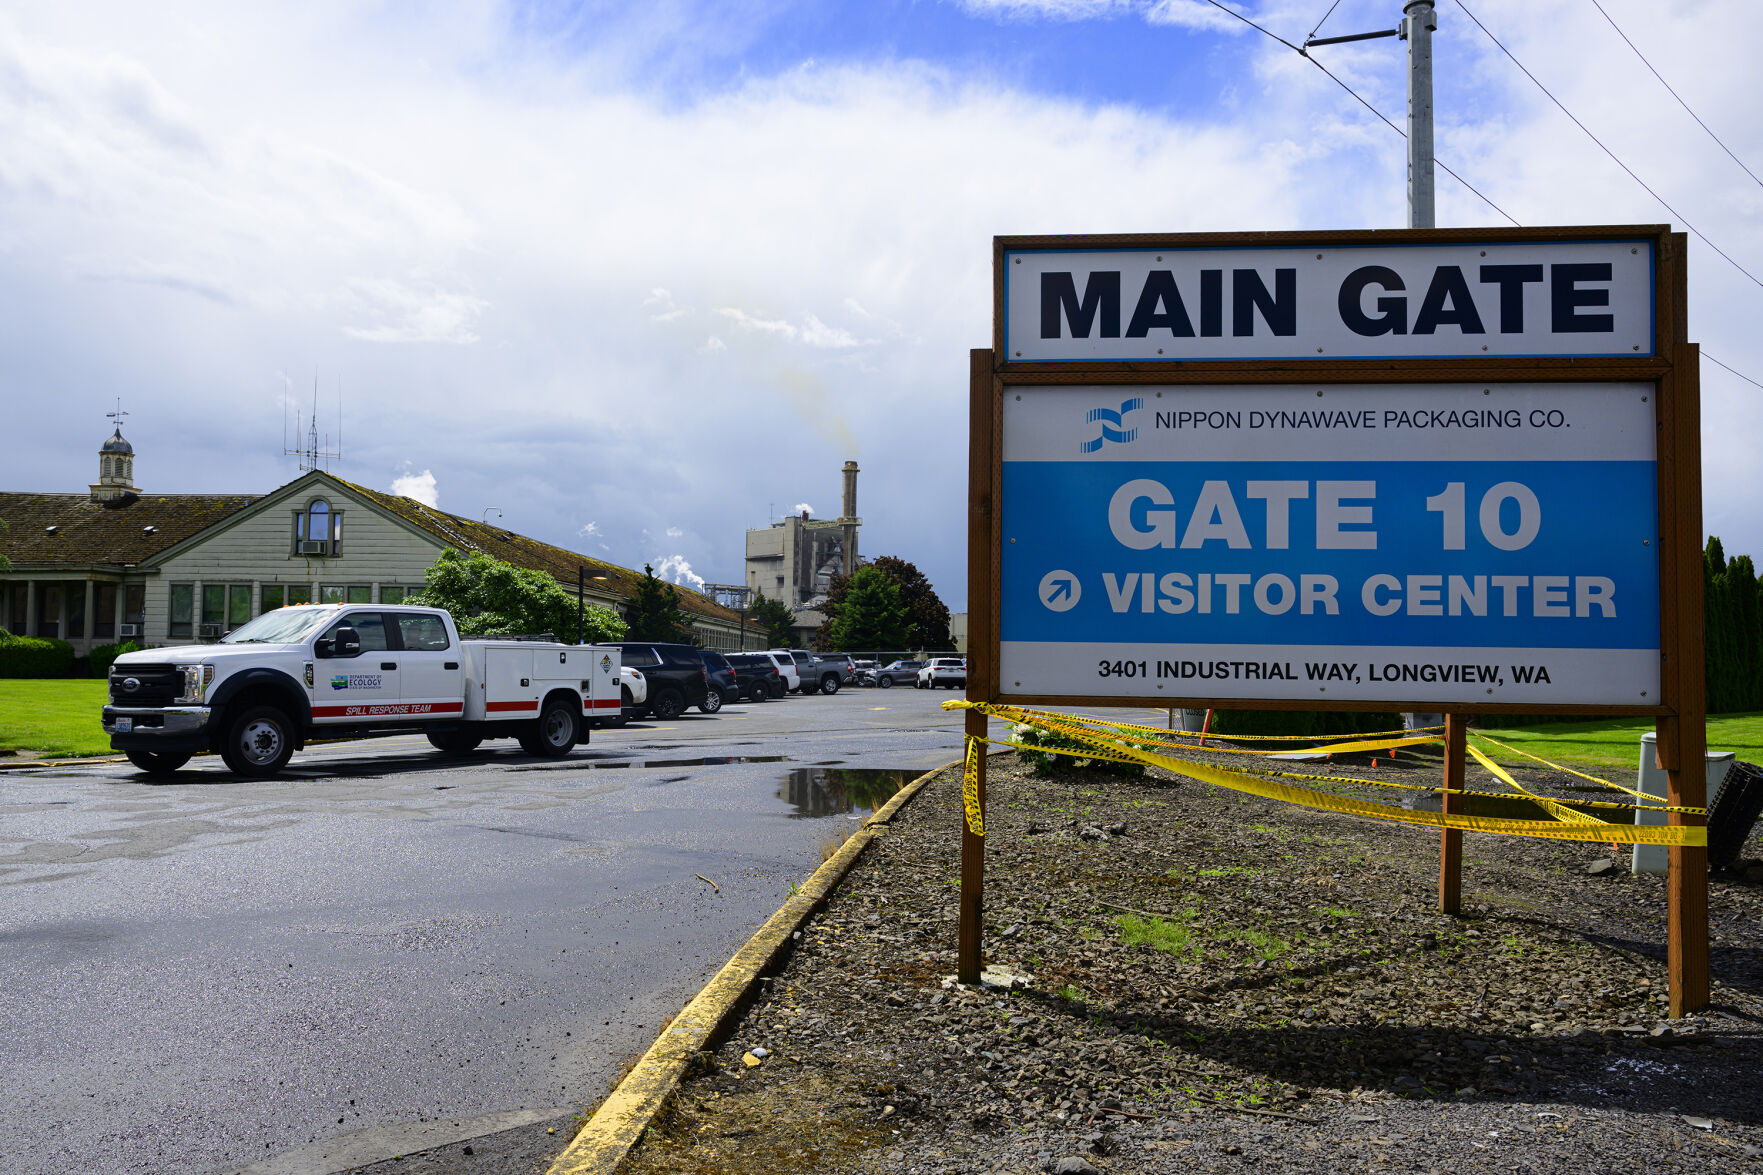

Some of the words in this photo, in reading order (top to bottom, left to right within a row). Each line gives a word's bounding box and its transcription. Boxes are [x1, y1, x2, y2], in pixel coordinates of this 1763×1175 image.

[1040, 268, 1297, 340] MAIN
[1337, 263, 1615, 338] GATE
[1155, 410, 1241, 430] NIPPON
[1249, 410, 1377, 430] DYNAWAVE
[1383, 408, 1522, 429] PACKAGING
[1528, 408, 1573, 429] CO.
[1107, 478, 1379, 550] GATE
[1425, 481, 1542, 551] 10
[1102, 572, 1340, 615] VISITOR
[1361, 573, 1618, 618] CENTER
[1097, 659, 1148, 679] 3401
[1155, 660, 1299, 681] INDUSTRIAL
[1304, 662, 1361, 685] WAY,
[1368, 663, 1504, 688] LONGVIEW,
[1510, 665, 1552, 685] WA
[345, 706, 367, 716] SPILL
[369, 704, 409, 715] RESPONSE
[411, 704, 432, 713] TEAM
